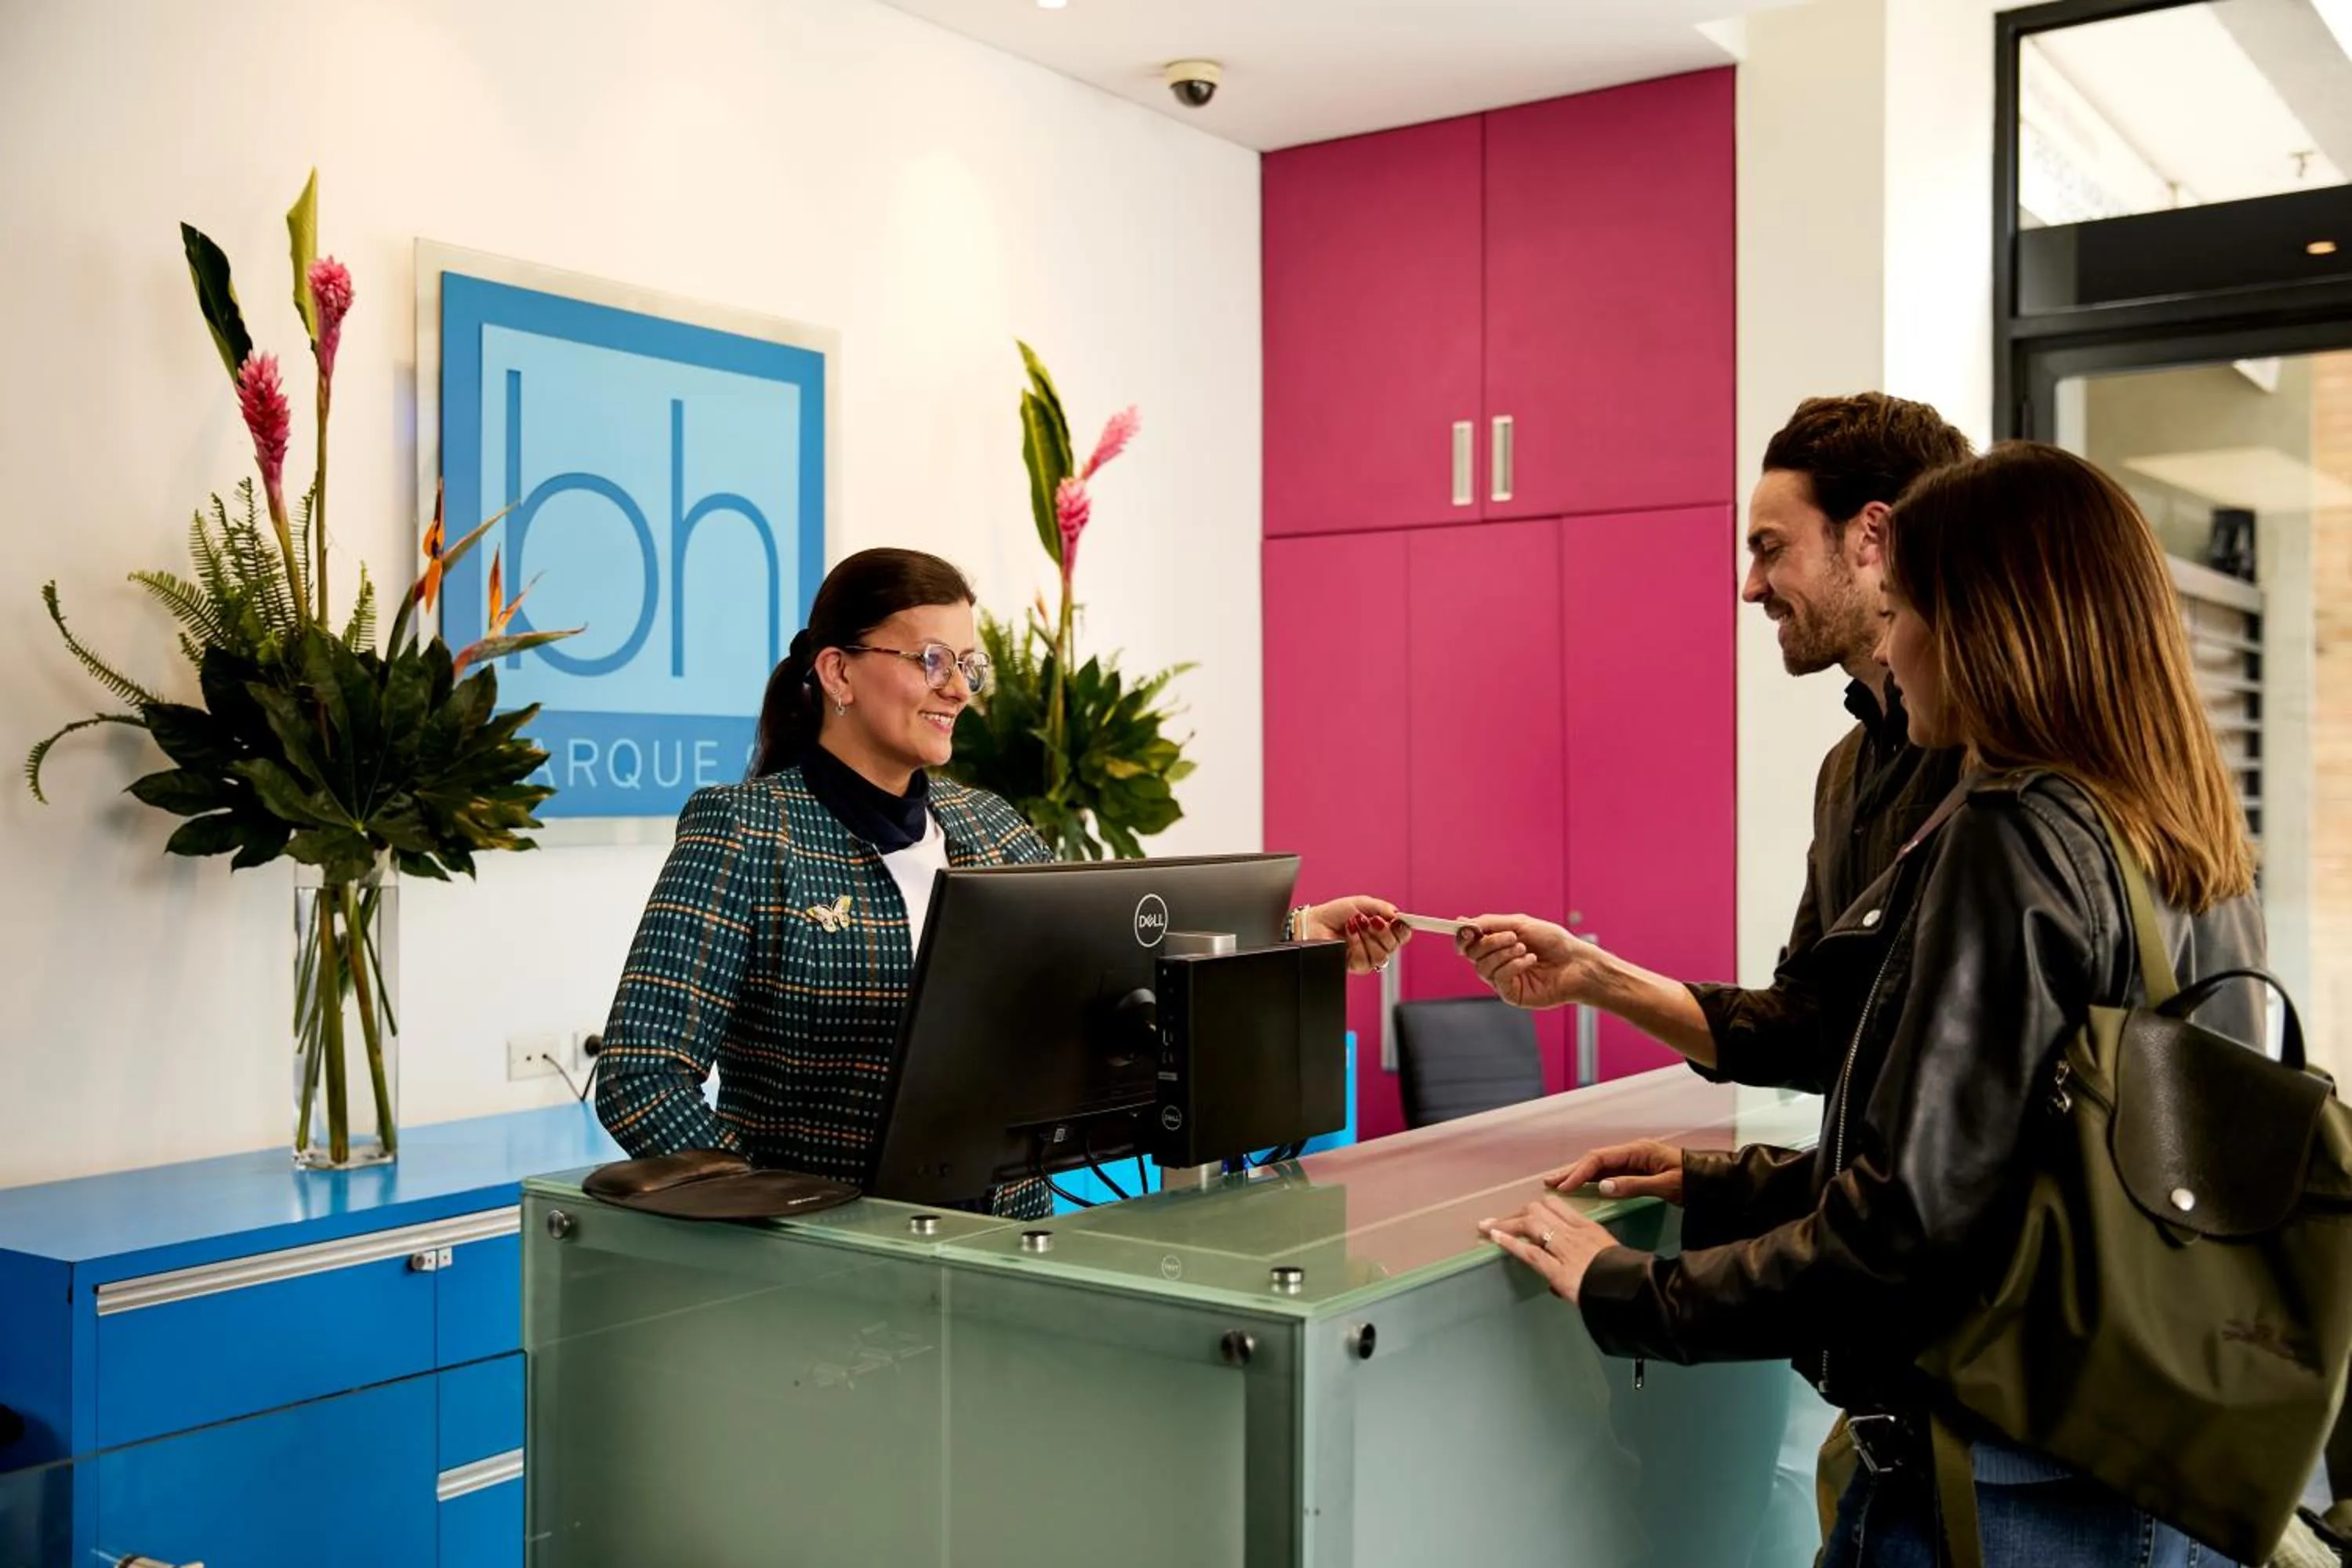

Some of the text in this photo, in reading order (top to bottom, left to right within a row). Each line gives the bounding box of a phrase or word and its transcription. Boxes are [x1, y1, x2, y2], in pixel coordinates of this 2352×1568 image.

[506, 369, 779, 677] bh
[514, 737, 719, 790] ARQUE
[1139, 913, 1164, 928] DELL
